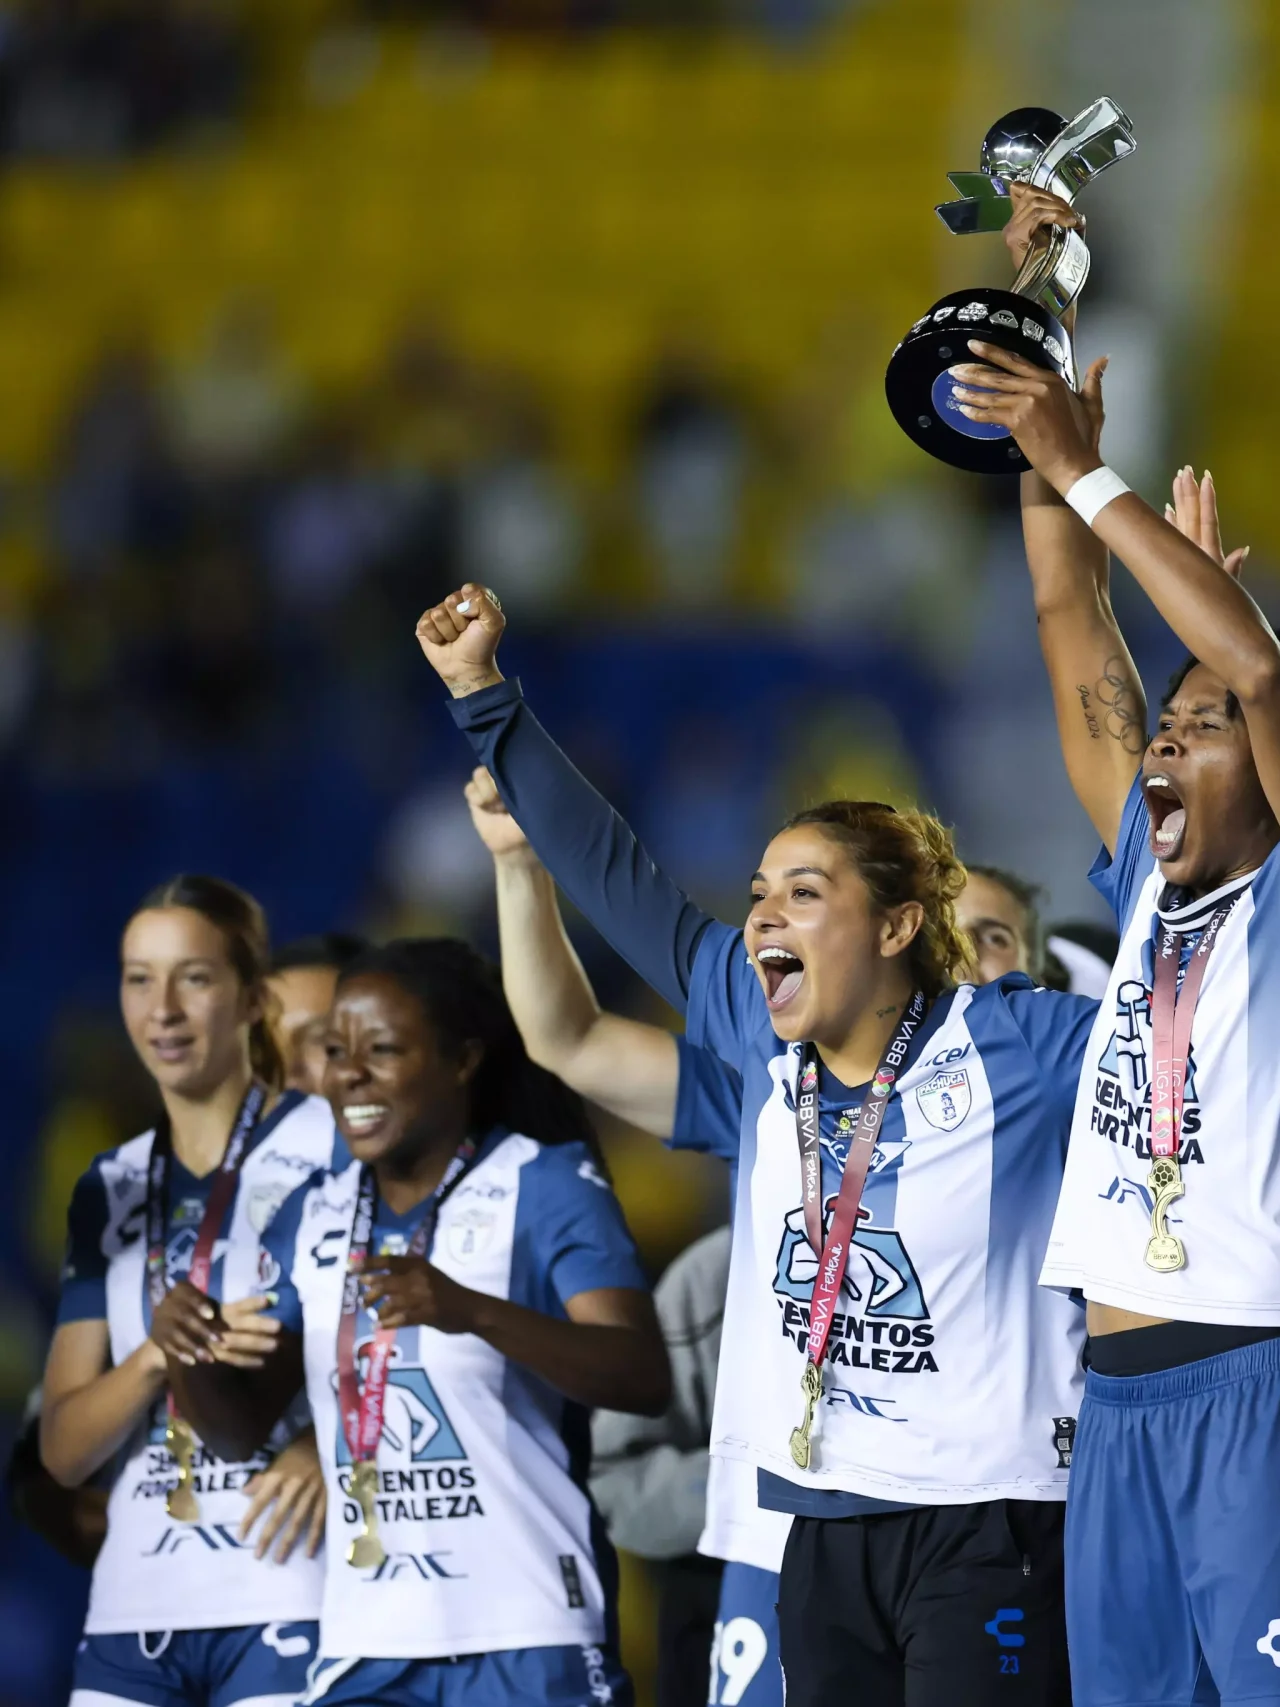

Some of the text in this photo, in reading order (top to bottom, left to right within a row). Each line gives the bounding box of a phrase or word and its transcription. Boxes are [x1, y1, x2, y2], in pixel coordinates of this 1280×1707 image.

[858, 1100, 883, 1143] LIGA
[886, 1020, 918, 1067] BBVA
[919, 1072, 965, 1095] PACHUCA
[1156, 1059, 1169, 1104] LIGA
[800, 1093, 817, 1148] BBVA
[808, 1298, 831, 1349] BBVA
